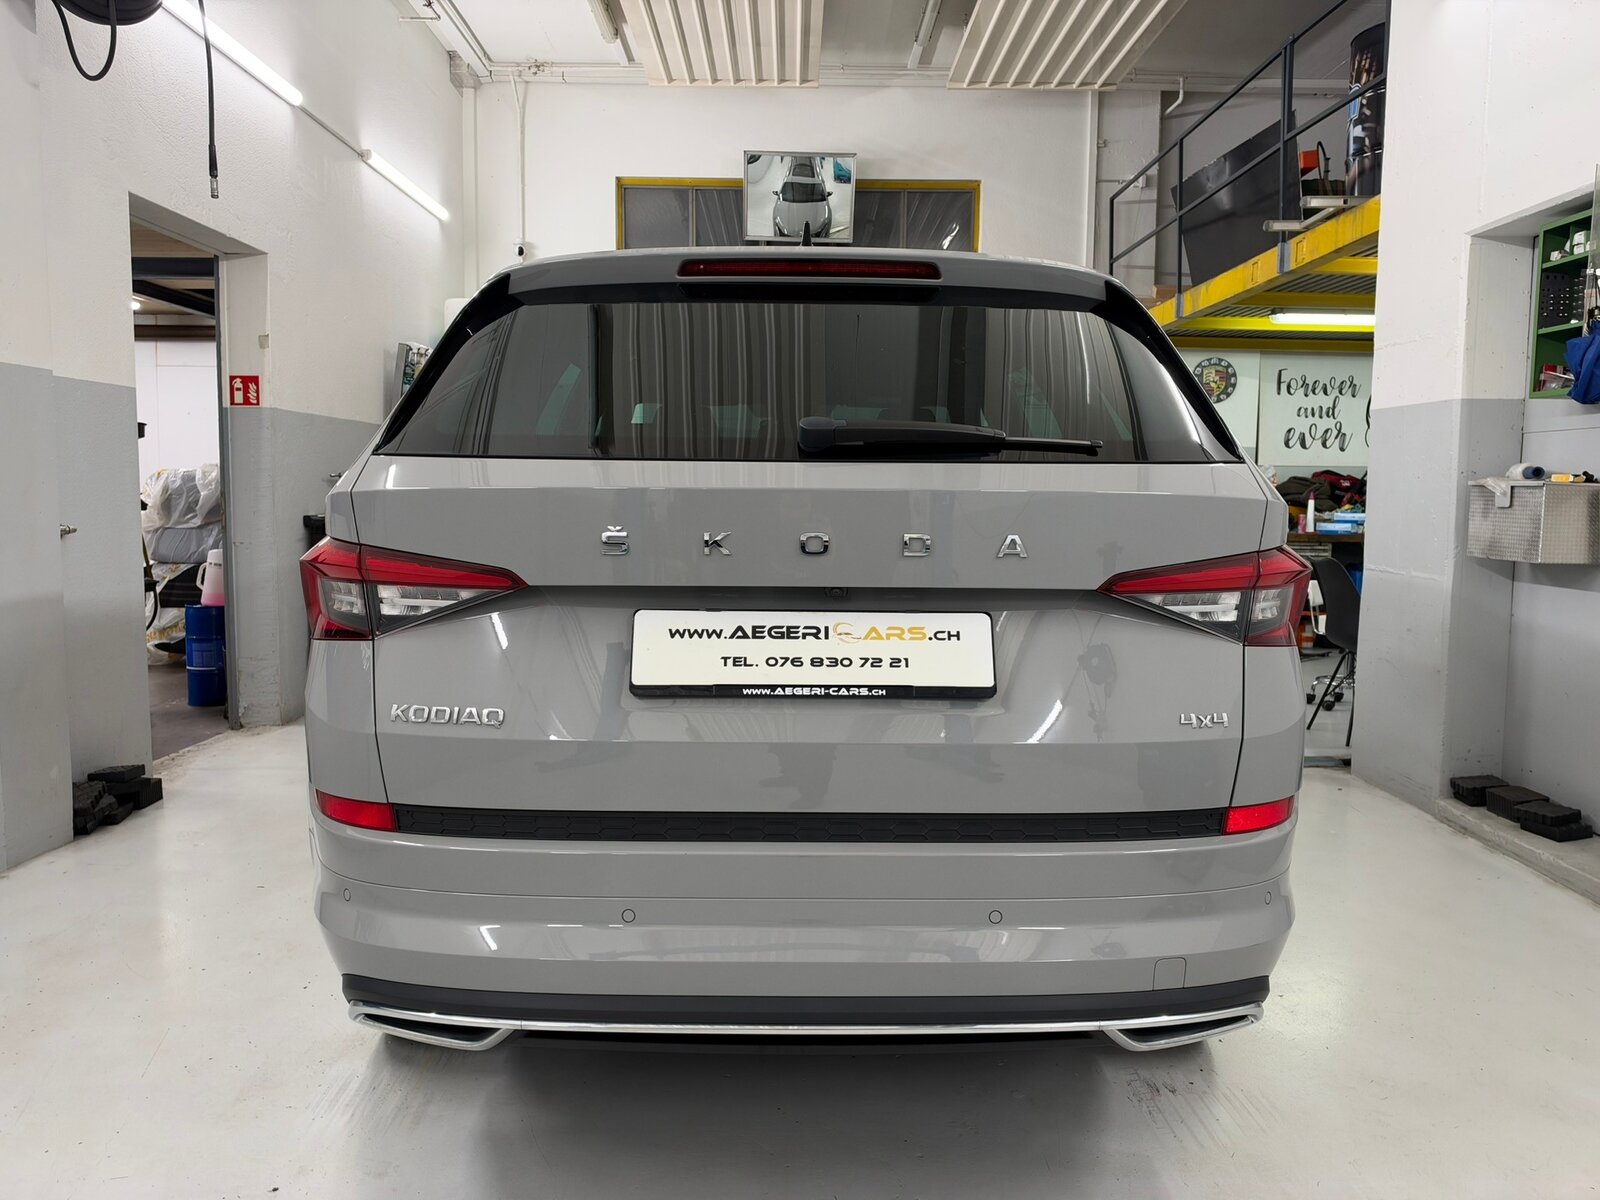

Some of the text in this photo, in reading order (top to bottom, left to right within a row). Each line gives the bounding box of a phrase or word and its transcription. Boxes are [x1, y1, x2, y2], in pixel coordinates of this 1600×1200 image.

[1276, 367, 1362, 398] Forever
[1296, 395, 1341, 420] and
[1283, 421, 1354, 452] ever
[600, 525, 1029, 560] ŠKODA
[720, 655, 910, 669] TEL. 076 830 72 21
[390, 703, 506, 730] KODIAQ
